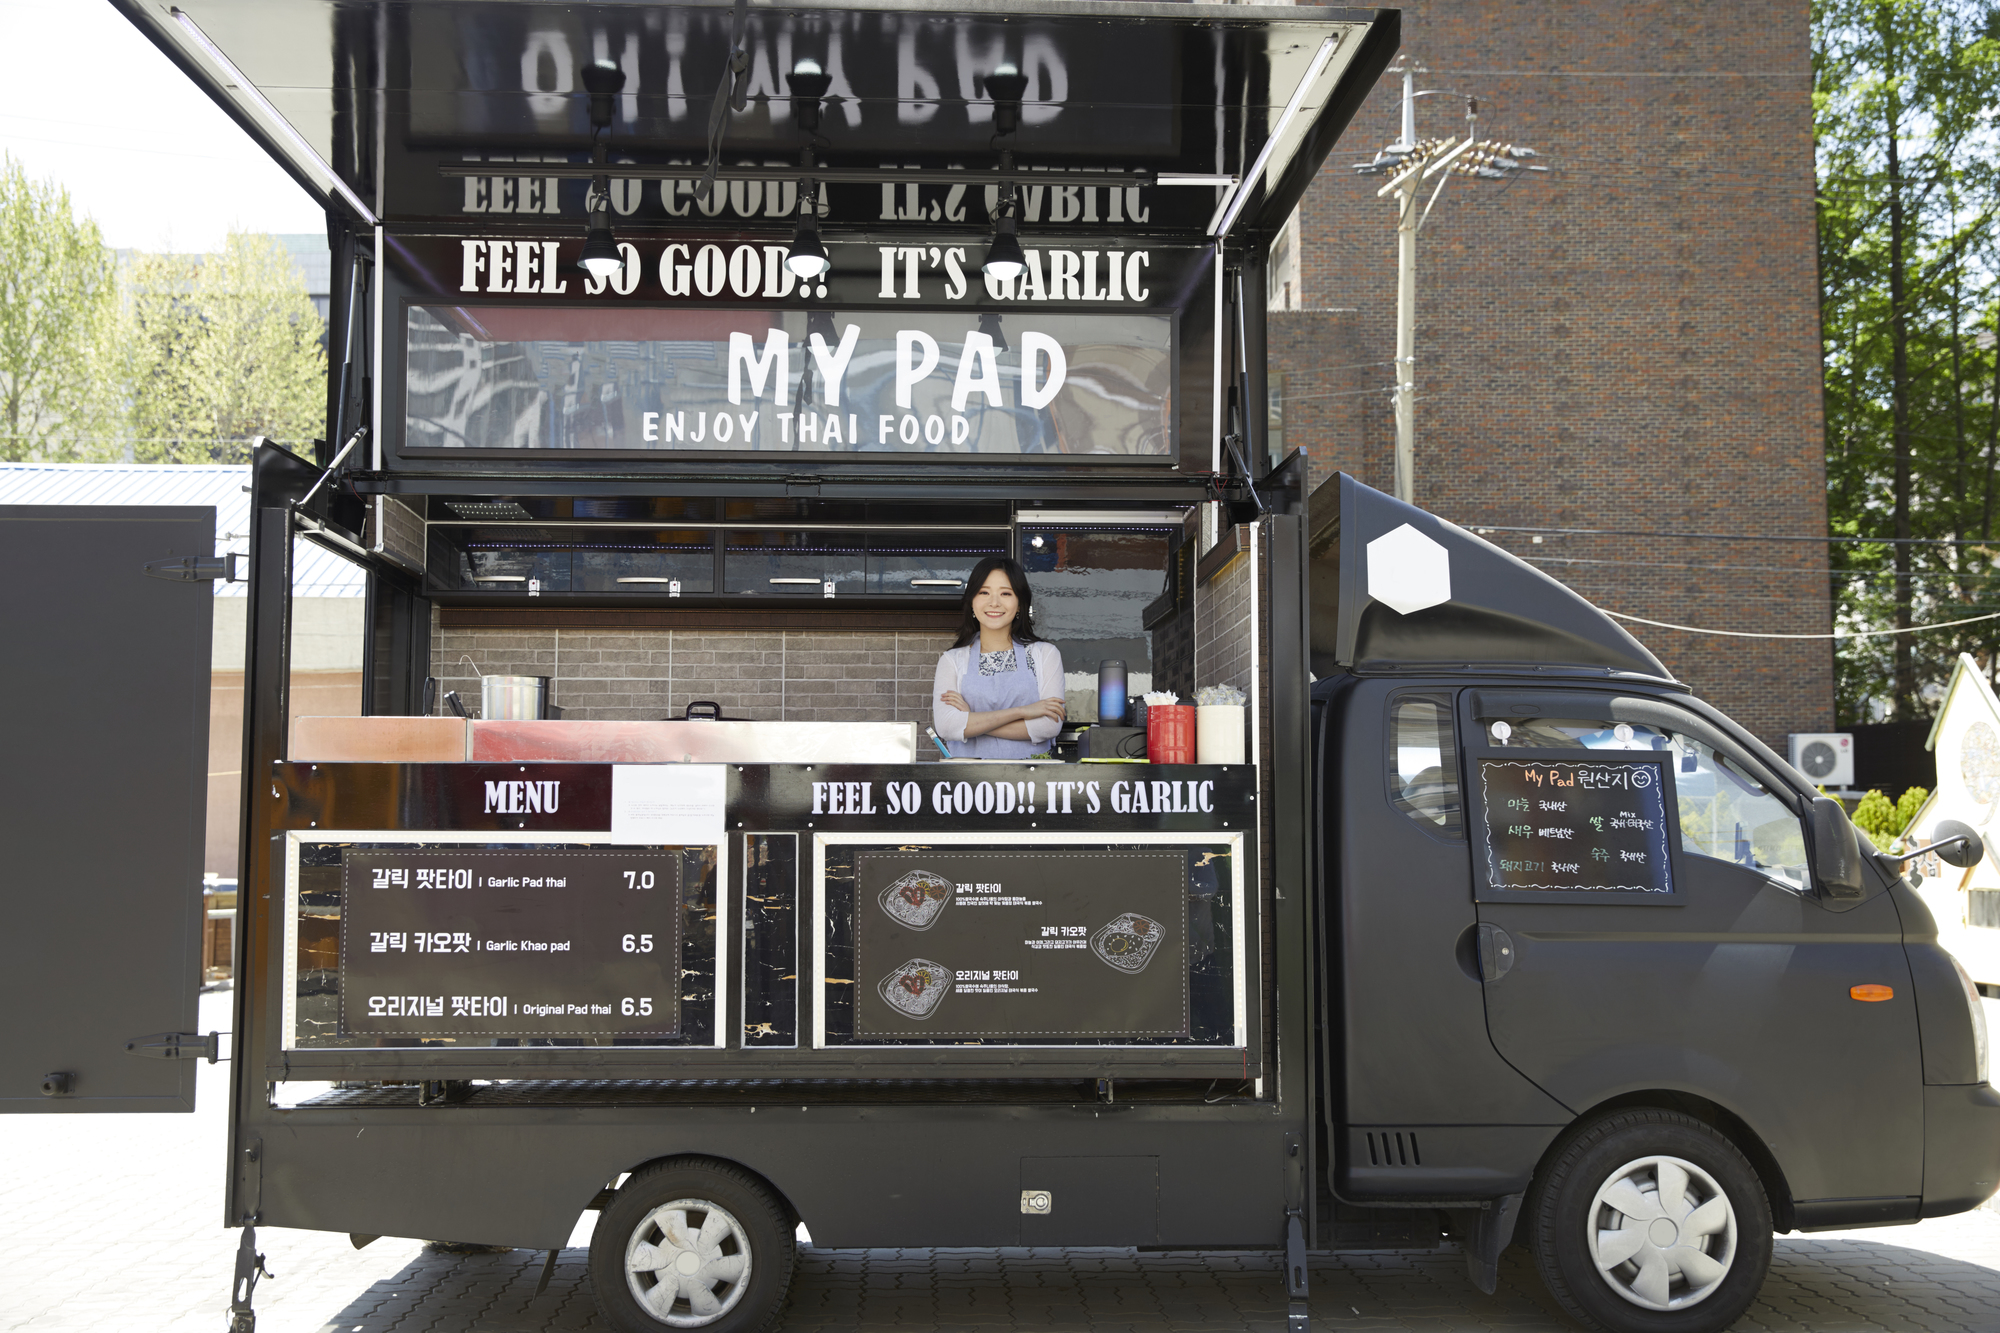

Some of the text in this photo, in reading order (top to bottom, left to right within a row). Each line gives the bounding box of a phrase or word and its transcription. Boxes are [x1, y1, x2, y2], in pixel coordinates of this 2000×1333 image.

[460, 240, 567, 294] FEEL
[878, 247, 967, 299] IT'S
[983, 250, 1150, 301] GARLIC
[728, 324, 1066, 411] MY PAD
[643, 411, 970, 445] ENJOY THAI FOOD
[1525, 769, 1628, 790] My Pad 원산지
[484, 781, 560, 814] MENU
[811, 780, 1214, 815] FEEL SO GOOD!! IT'S GARLIC
[1507, 797, 1567, 812] 마늘 국내산
[1508, 825, 1575, 839] 새우 베트남산
[1589, 816, 1603, 832] 쌀
[1591, 847, 1647, 863] 숙주 국내산
[1499, 859, 1580, 874] 돼지고기 국내산
[372, 869, 655, 889] 갈릭 팟타이 Garlic Pad thai 7.0
[955, 883, 1002, 893] 갈릭 팟타이
[1041, 926, 1087, 936] 갈릭 카오팟
[370, 932, 407, 953] 갈릭
[414, 932, 471, 953] 카오팟
[486, 941, 518, 951] Garlic
[521, 941, 547, 951] Khao
[551, 941, 570, 952] pad
[955, 970, 1019, 980] 오리지널 팟타이
[368, 996, 653, 1017] 오리지널 팟타이 Original Pad thai 6.5
